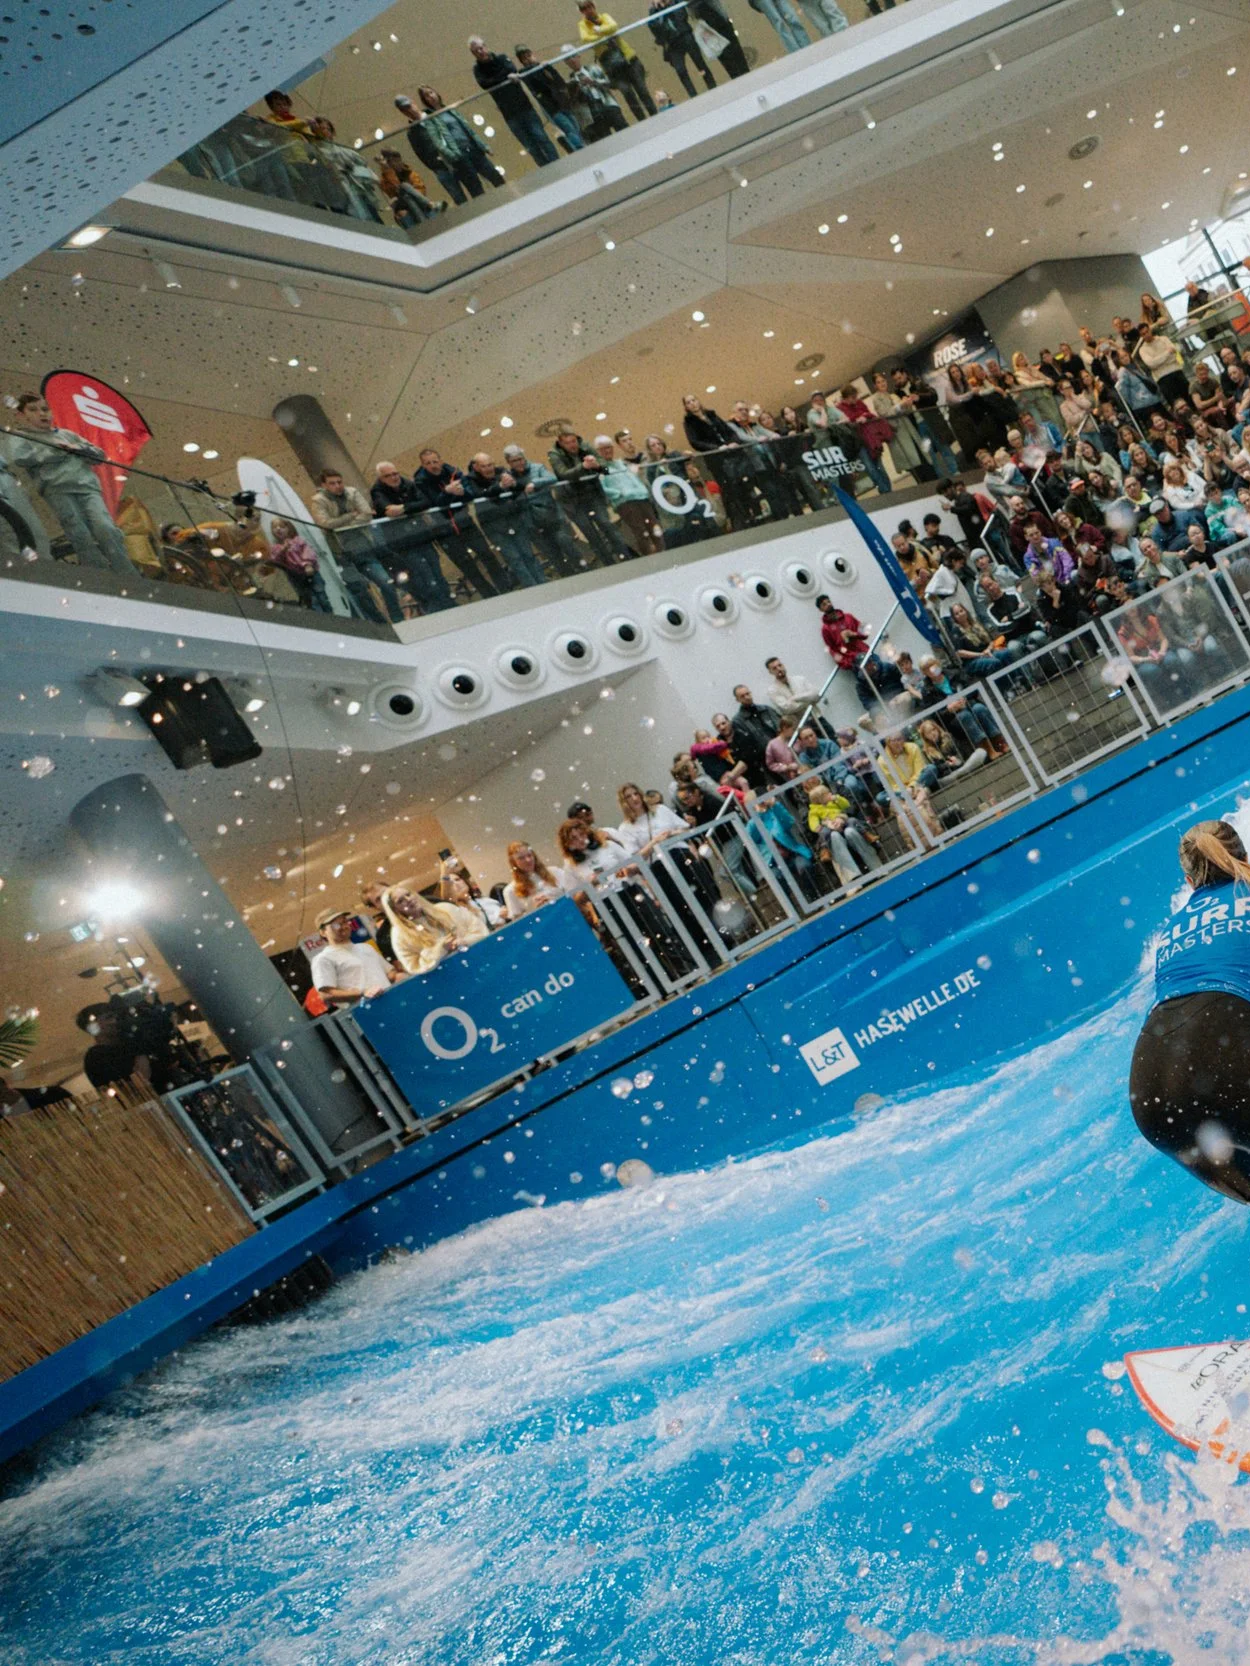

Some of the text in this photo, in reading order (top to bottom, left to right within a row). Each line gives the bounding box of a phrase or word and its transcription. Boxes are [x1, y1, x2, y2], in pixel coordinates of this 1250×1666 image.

[933, 337, 968, 369] ROSE
[810, 459, 866, 482] MASTERS
[501, 989, 543, 1019] can
[544, 972, 575, 996] do
[810, 969, 981, 1072] L&T HASEWELLE.DE
